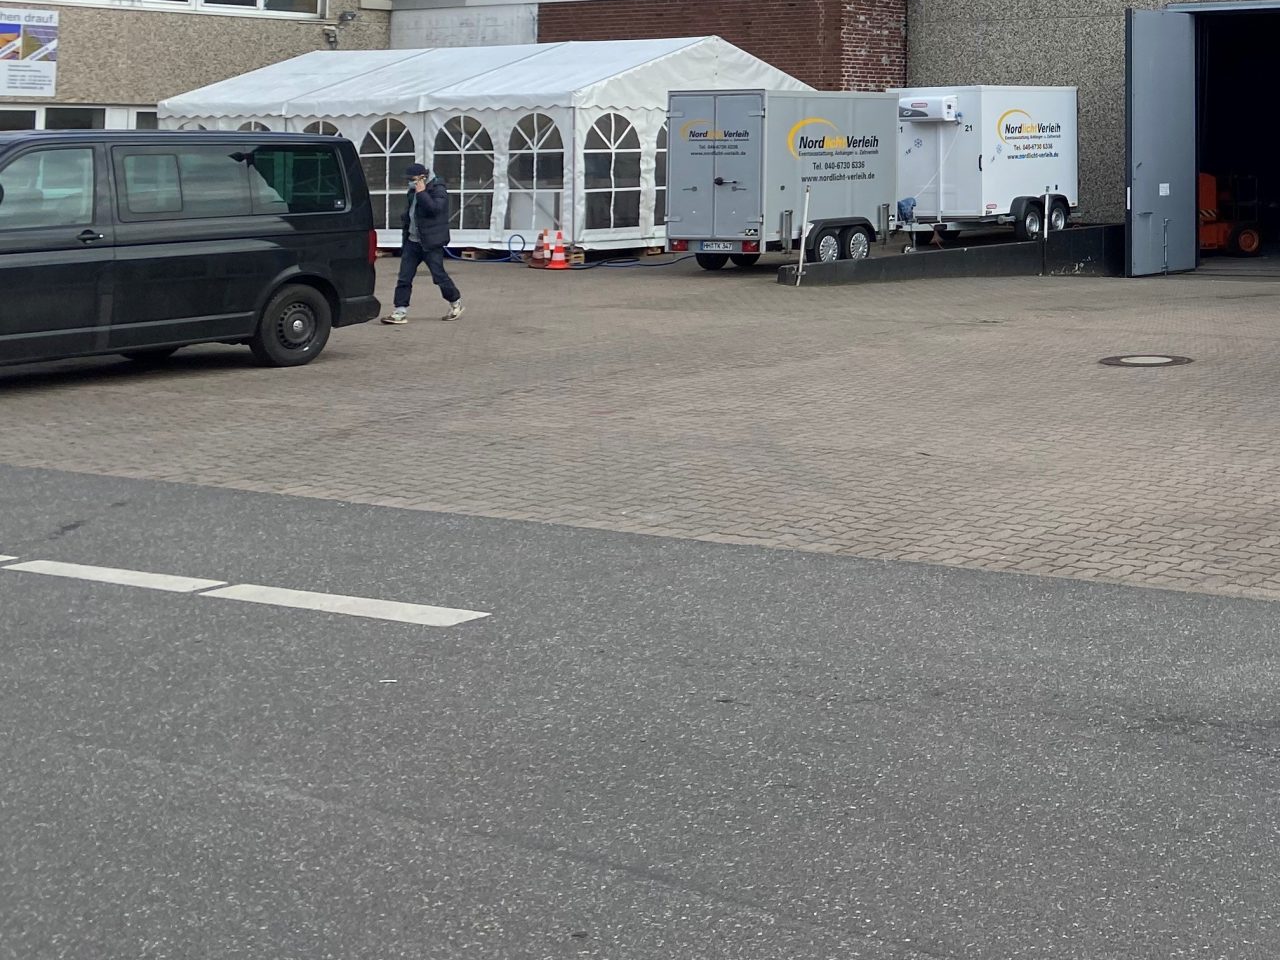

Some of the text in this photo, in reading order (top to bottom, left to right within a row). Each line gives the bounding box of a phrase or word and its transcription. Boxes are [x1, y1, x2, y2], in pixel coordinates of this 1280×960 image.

[813, 162, 823, 170] Tel.
[824, 161, 851, 170] 040-6730
[801, 172, 875, 182] www.nordlicht-verleih.de
